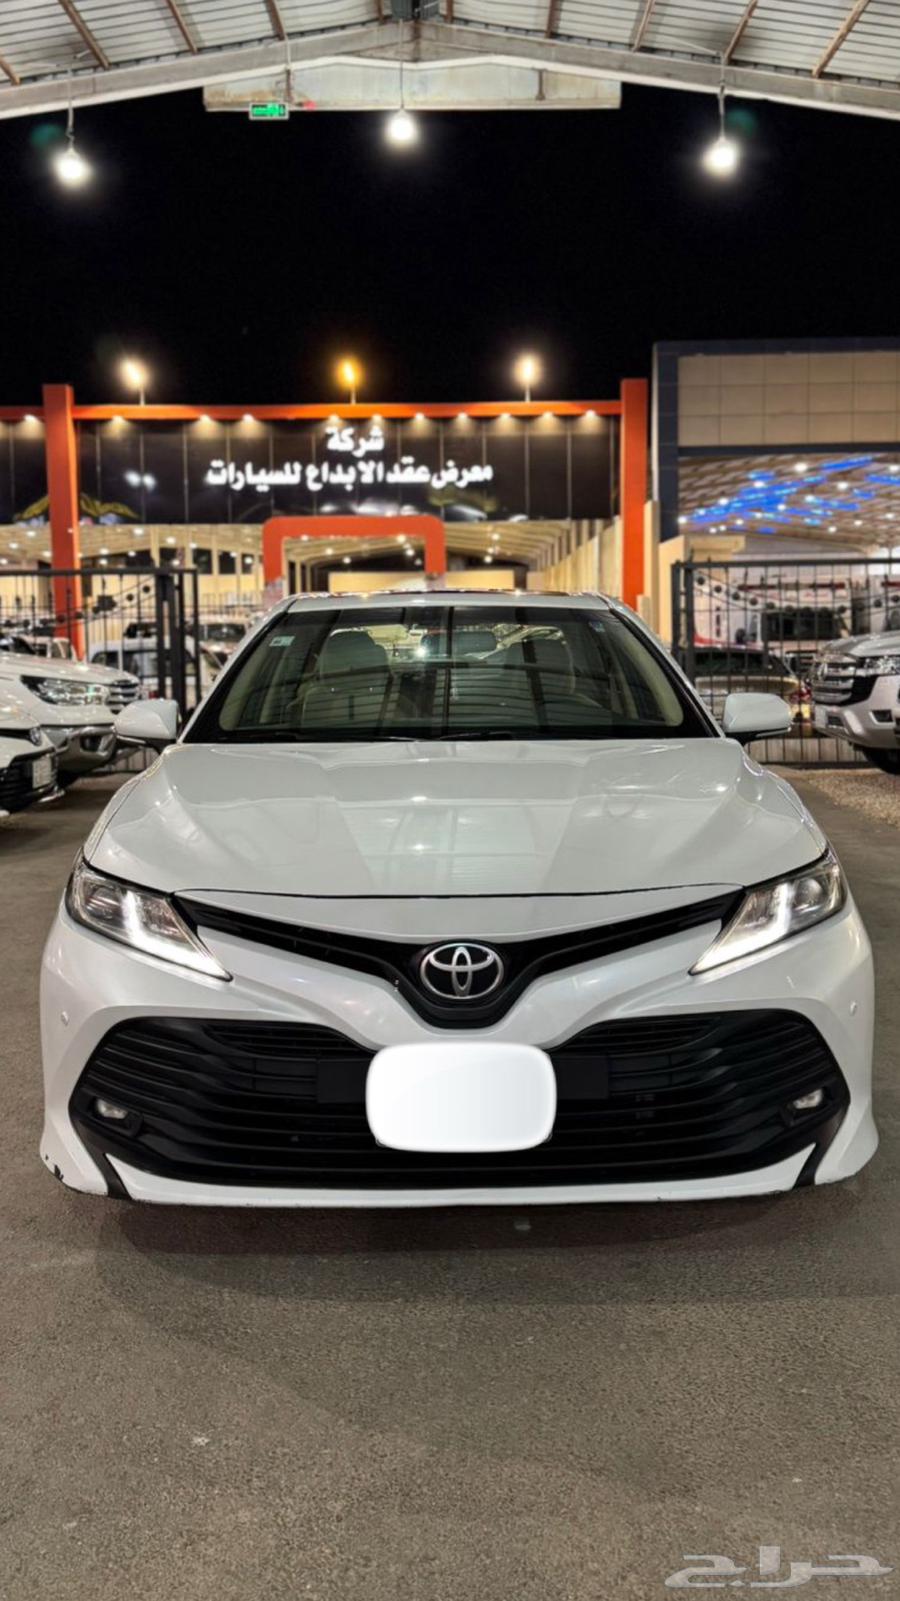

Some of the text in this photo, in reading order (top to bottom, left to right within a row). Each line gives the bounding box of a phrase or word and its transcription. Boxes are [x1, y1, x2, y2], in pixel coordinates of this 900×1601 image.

[326, 425, 385, 458] شركة
[205, 456, 494, 492] معرض عقد الابداع للسيارات
